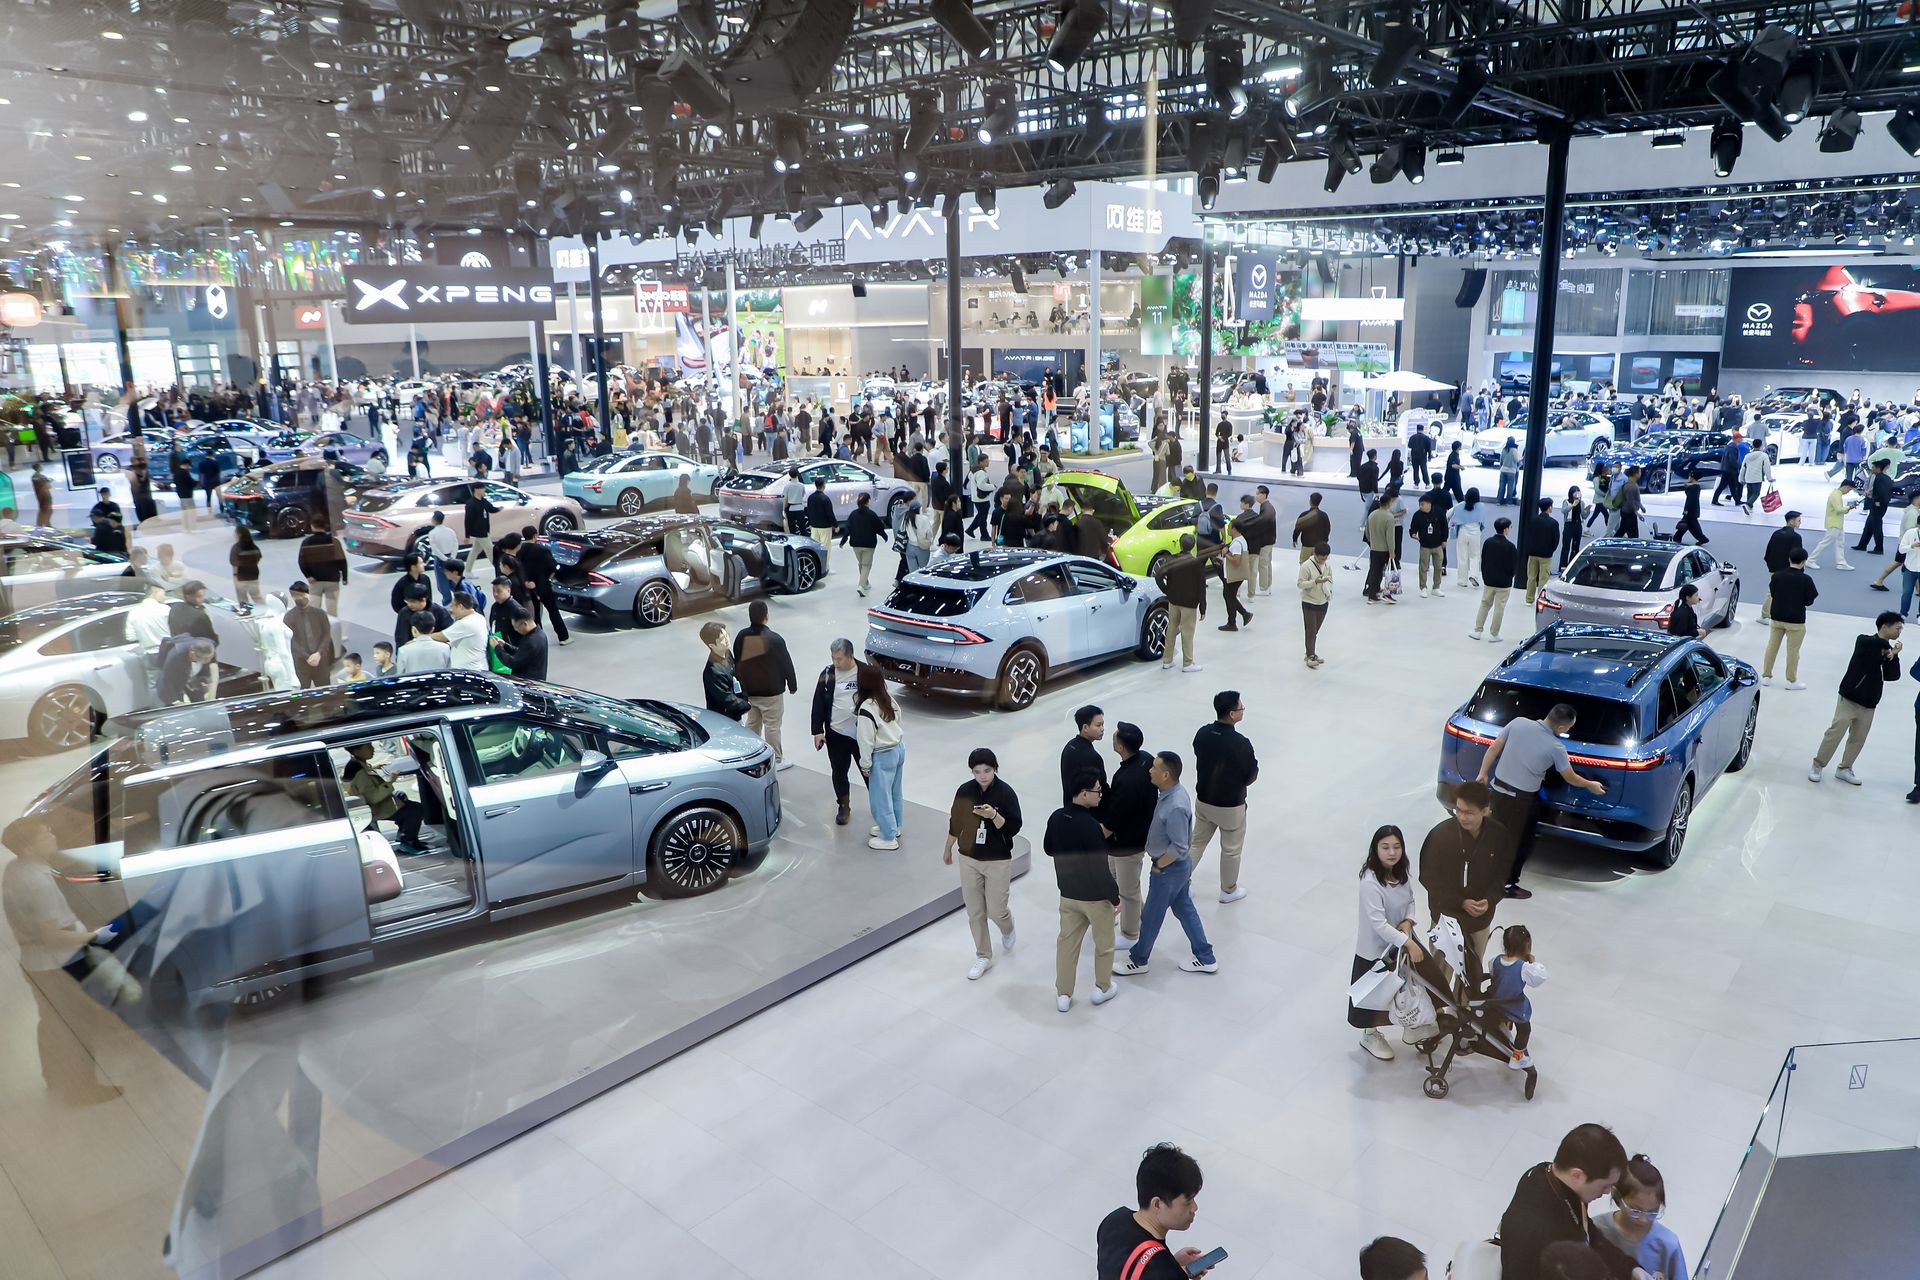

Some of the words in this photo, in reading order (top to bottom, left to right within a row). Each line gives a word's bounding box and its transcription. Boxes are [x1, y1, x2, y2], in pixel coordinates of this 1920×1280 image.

[1106, 204, 1163, 234] 阿维塔
[415, 285, 552, 303] XPENG
[1248, 290, 1268, 299] MAZDA
[1151, 311, 1163, 325] 11
[1140, 1254, 1148, 1264] GO
